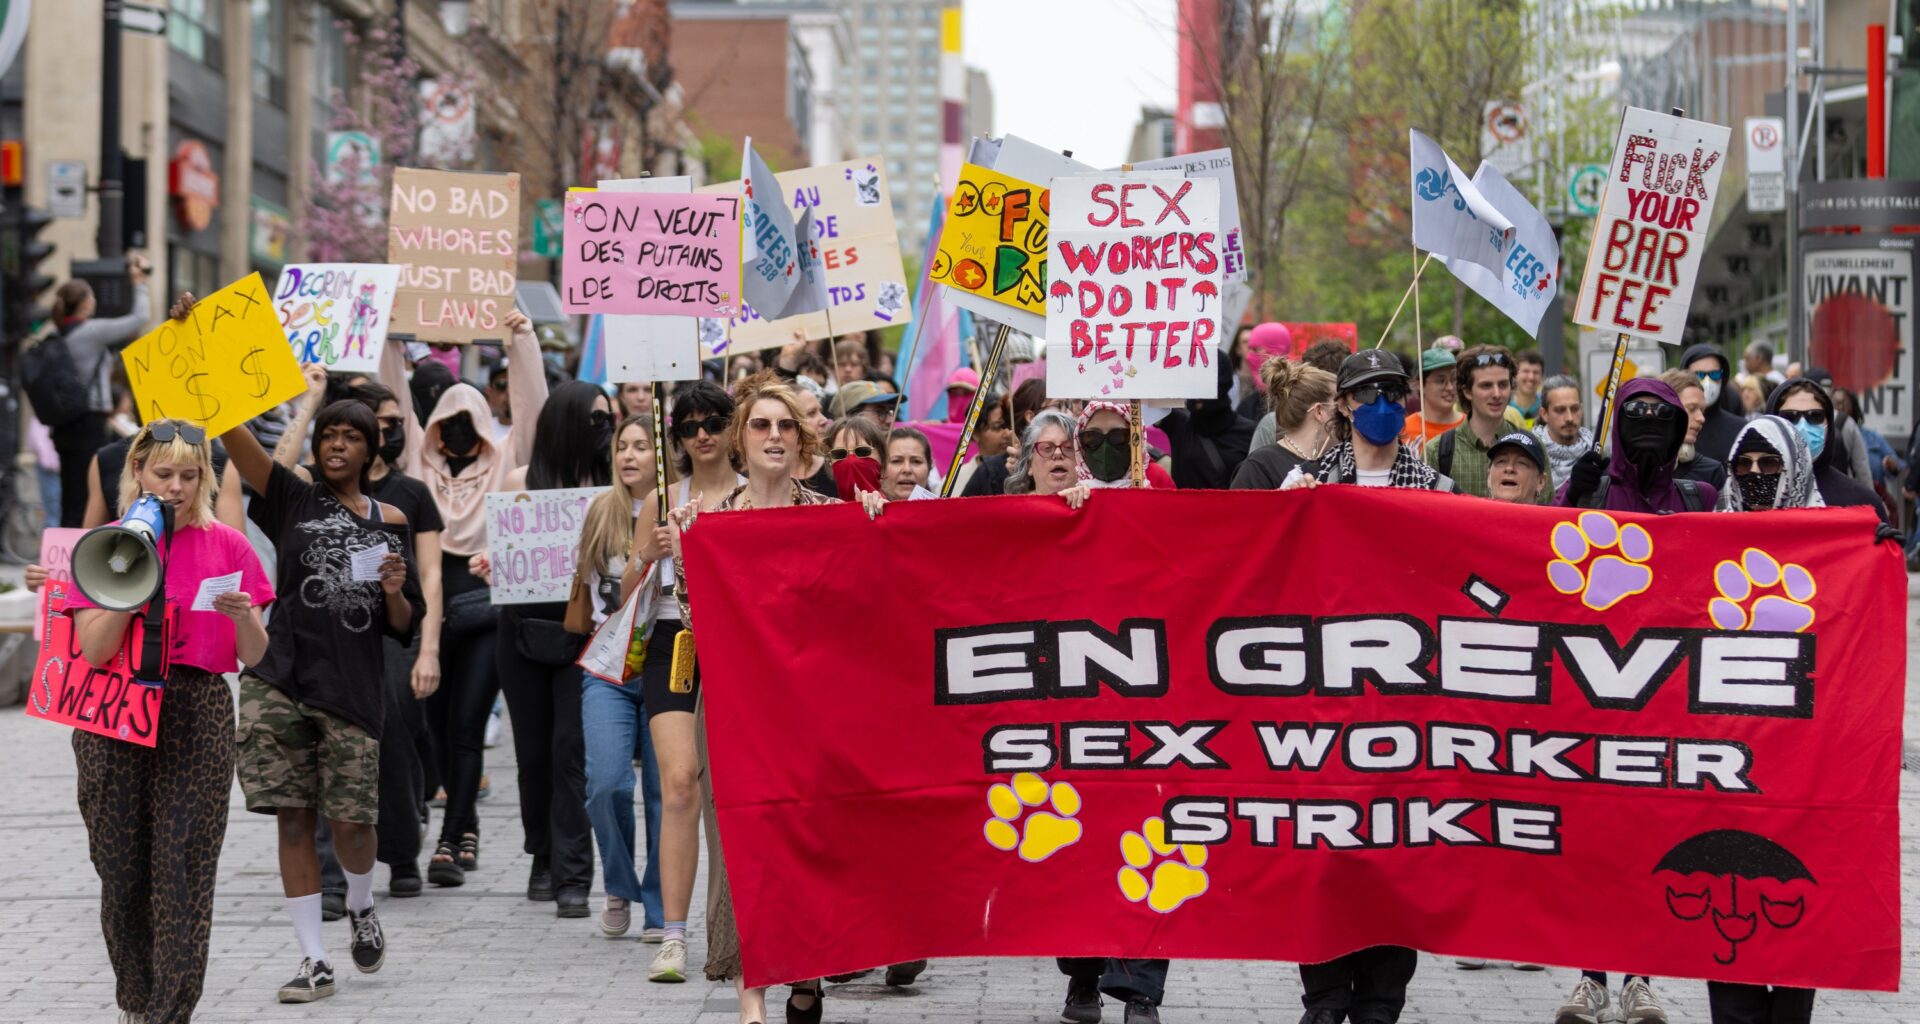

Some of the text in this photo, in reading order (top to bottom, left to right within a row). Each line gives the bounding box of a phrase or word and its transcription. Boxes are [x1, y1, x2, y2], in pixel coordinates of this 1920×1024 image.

[1619, 134, 1720, 200] FUCK
[393, 184, 508, 219] NO BAD
[584, 202, 639, 232] ON
[654, 207, 724, 237] VEUT
[1088, 181, 1192, 228] SEX
[1628, 187, 1700, 231] YOUR
[394, 227, 512, 256] WHORES
[581, 240, 722, 271] DES PUTAINS
[1057, 232, 1218, 275] WORKERS
[1603, 218, 1689, 287] BAR
[278, 268, 357, 300] DECRIM
[396, 266, 515, 296] JUST BAD
[755, 258, 779, 282] 298
[583, 276, 720, 304] DE DROITS
[1079, 278, 1187, 318] DO IT
[1512, 279, 1528, 301] 298
[1590, 272, 1673, 333] FEE
[418, 298, 498, 330] LAWS
[1071, 318, 1215, 369] BETTER
[498, 506, 525, 537] NO
[491, 550, 529, 588] NO
[935, 573, 1816, 719] EN GRÈVE
[32, 656, 158, 738] SWERFS
[982, 720, 1763, 794] SEX WORKER
[1164, 795, 1561, 855] STRIKE
